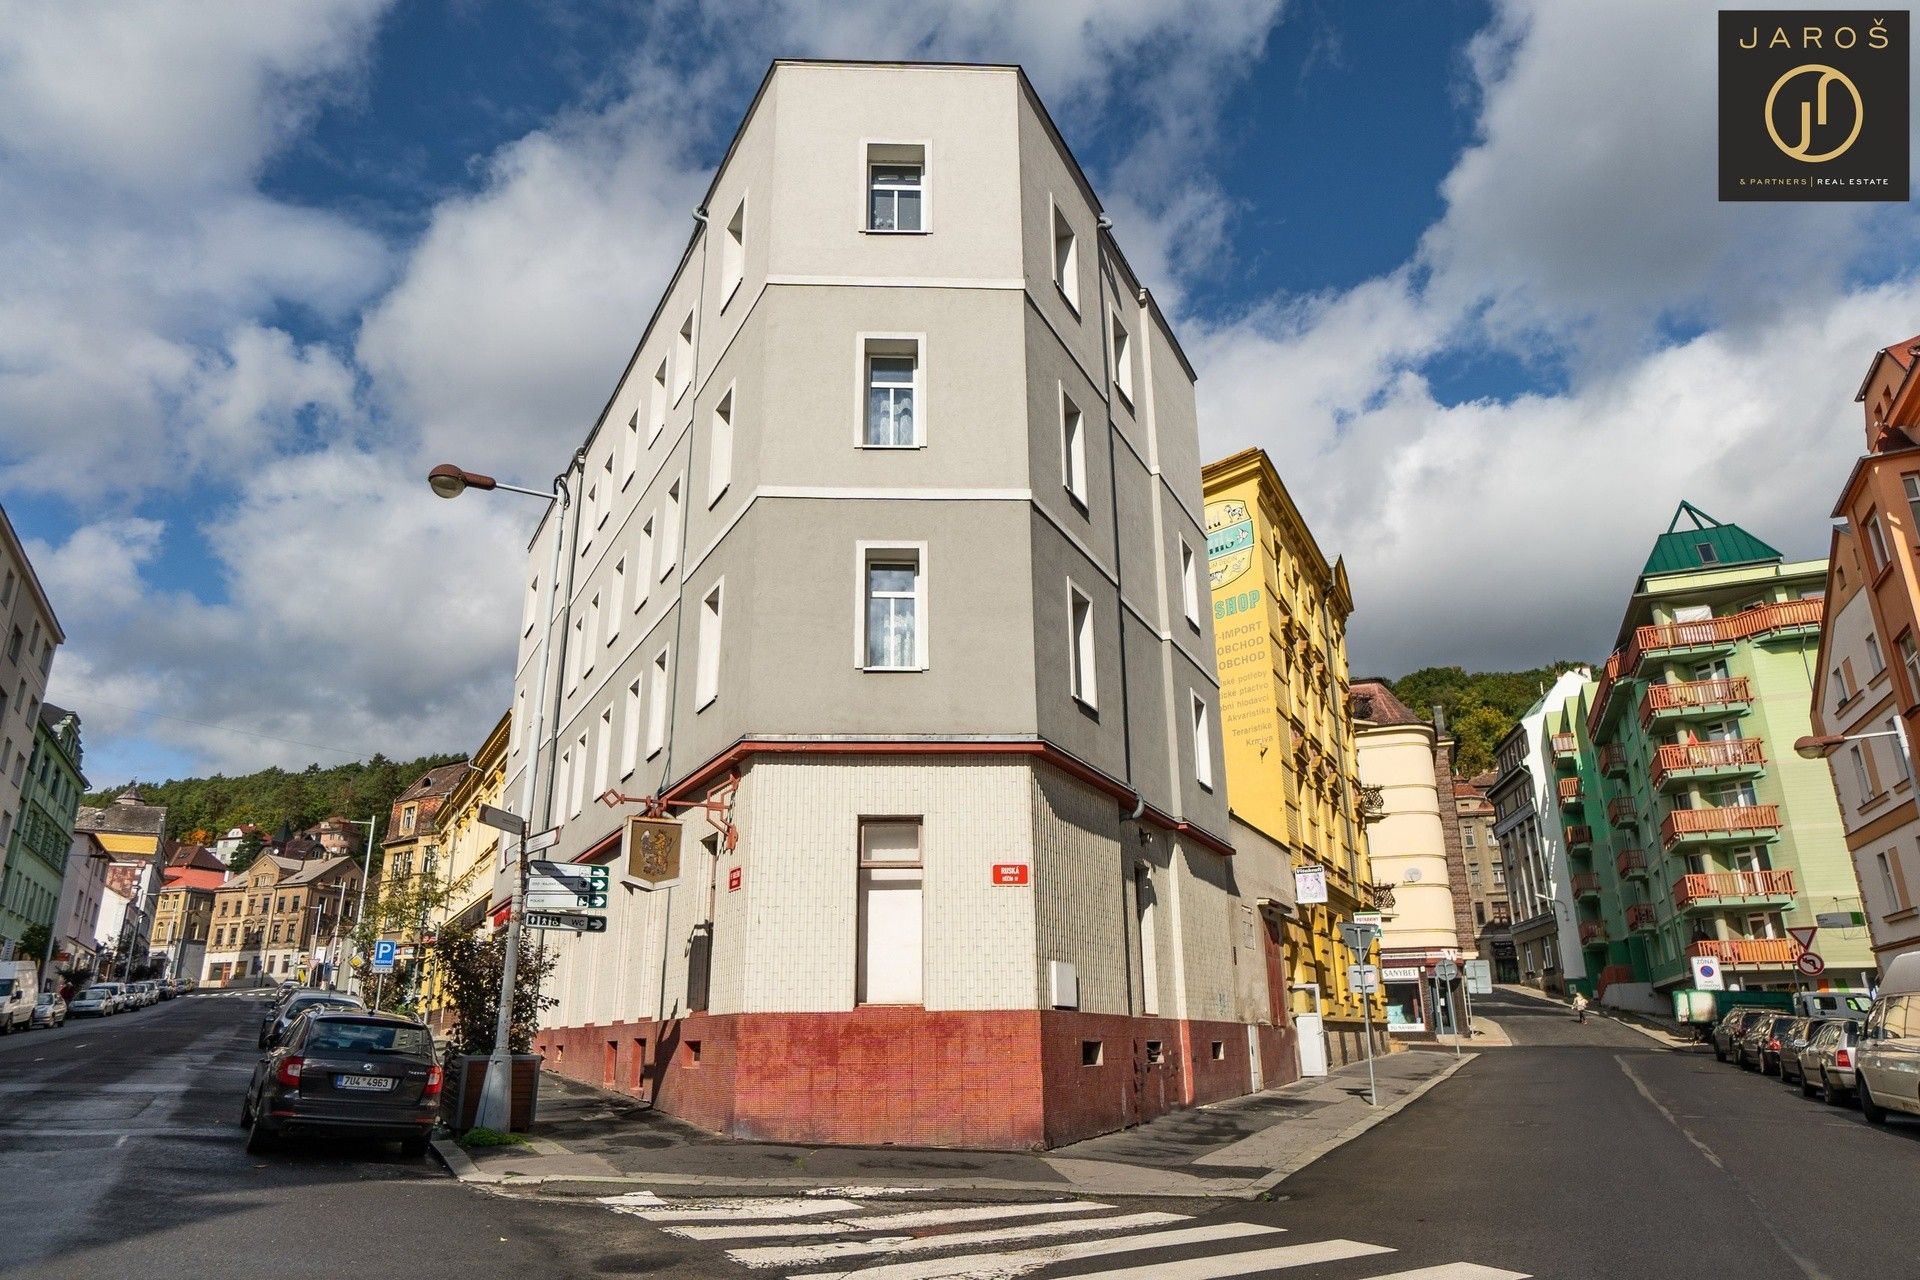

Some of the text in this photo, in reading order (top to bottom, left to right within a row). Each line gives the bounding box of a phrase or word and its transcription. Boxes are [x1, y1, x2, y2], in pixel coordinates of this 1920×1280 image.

[1214, 589, 1261, 619] SHOP
[1217, 636, 1264, 657] OBCHOD
[1218, 650, 1266, 671] OBCHOD
[571, 918, 585, 927] WC
[378, 943, 392, 959] P
[344, 1076, 389, 1088] 7U4 4963
